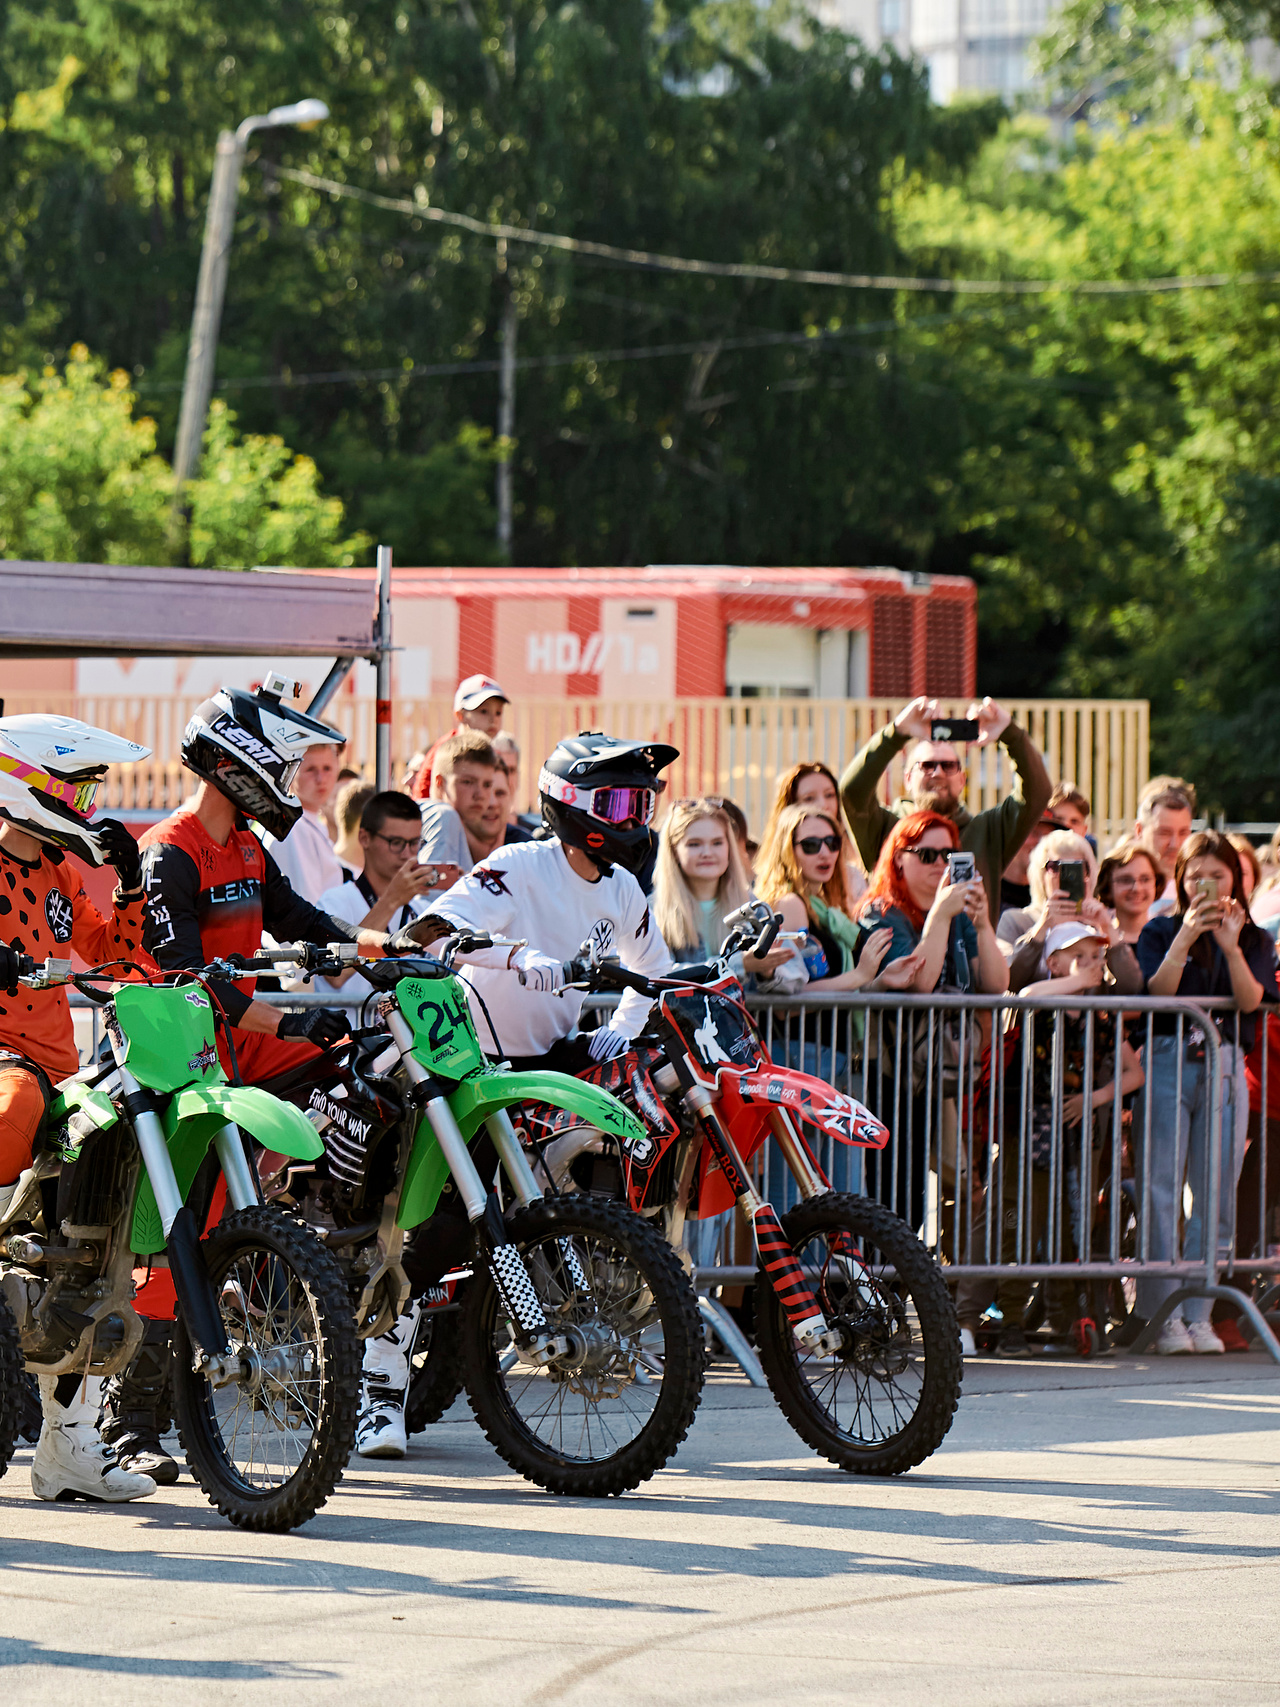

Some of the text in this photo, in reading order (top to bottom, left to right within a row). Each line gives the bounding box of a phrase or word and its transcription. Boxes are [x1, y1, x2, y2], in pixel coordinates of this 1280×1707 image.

[417, 999, 474, 1053] 24
[309, 1088, 372, 1144] FIND YOUR WAY
[624, 1137, 652, 1160] 13
[720, 1153, 742, 1190] BOX
